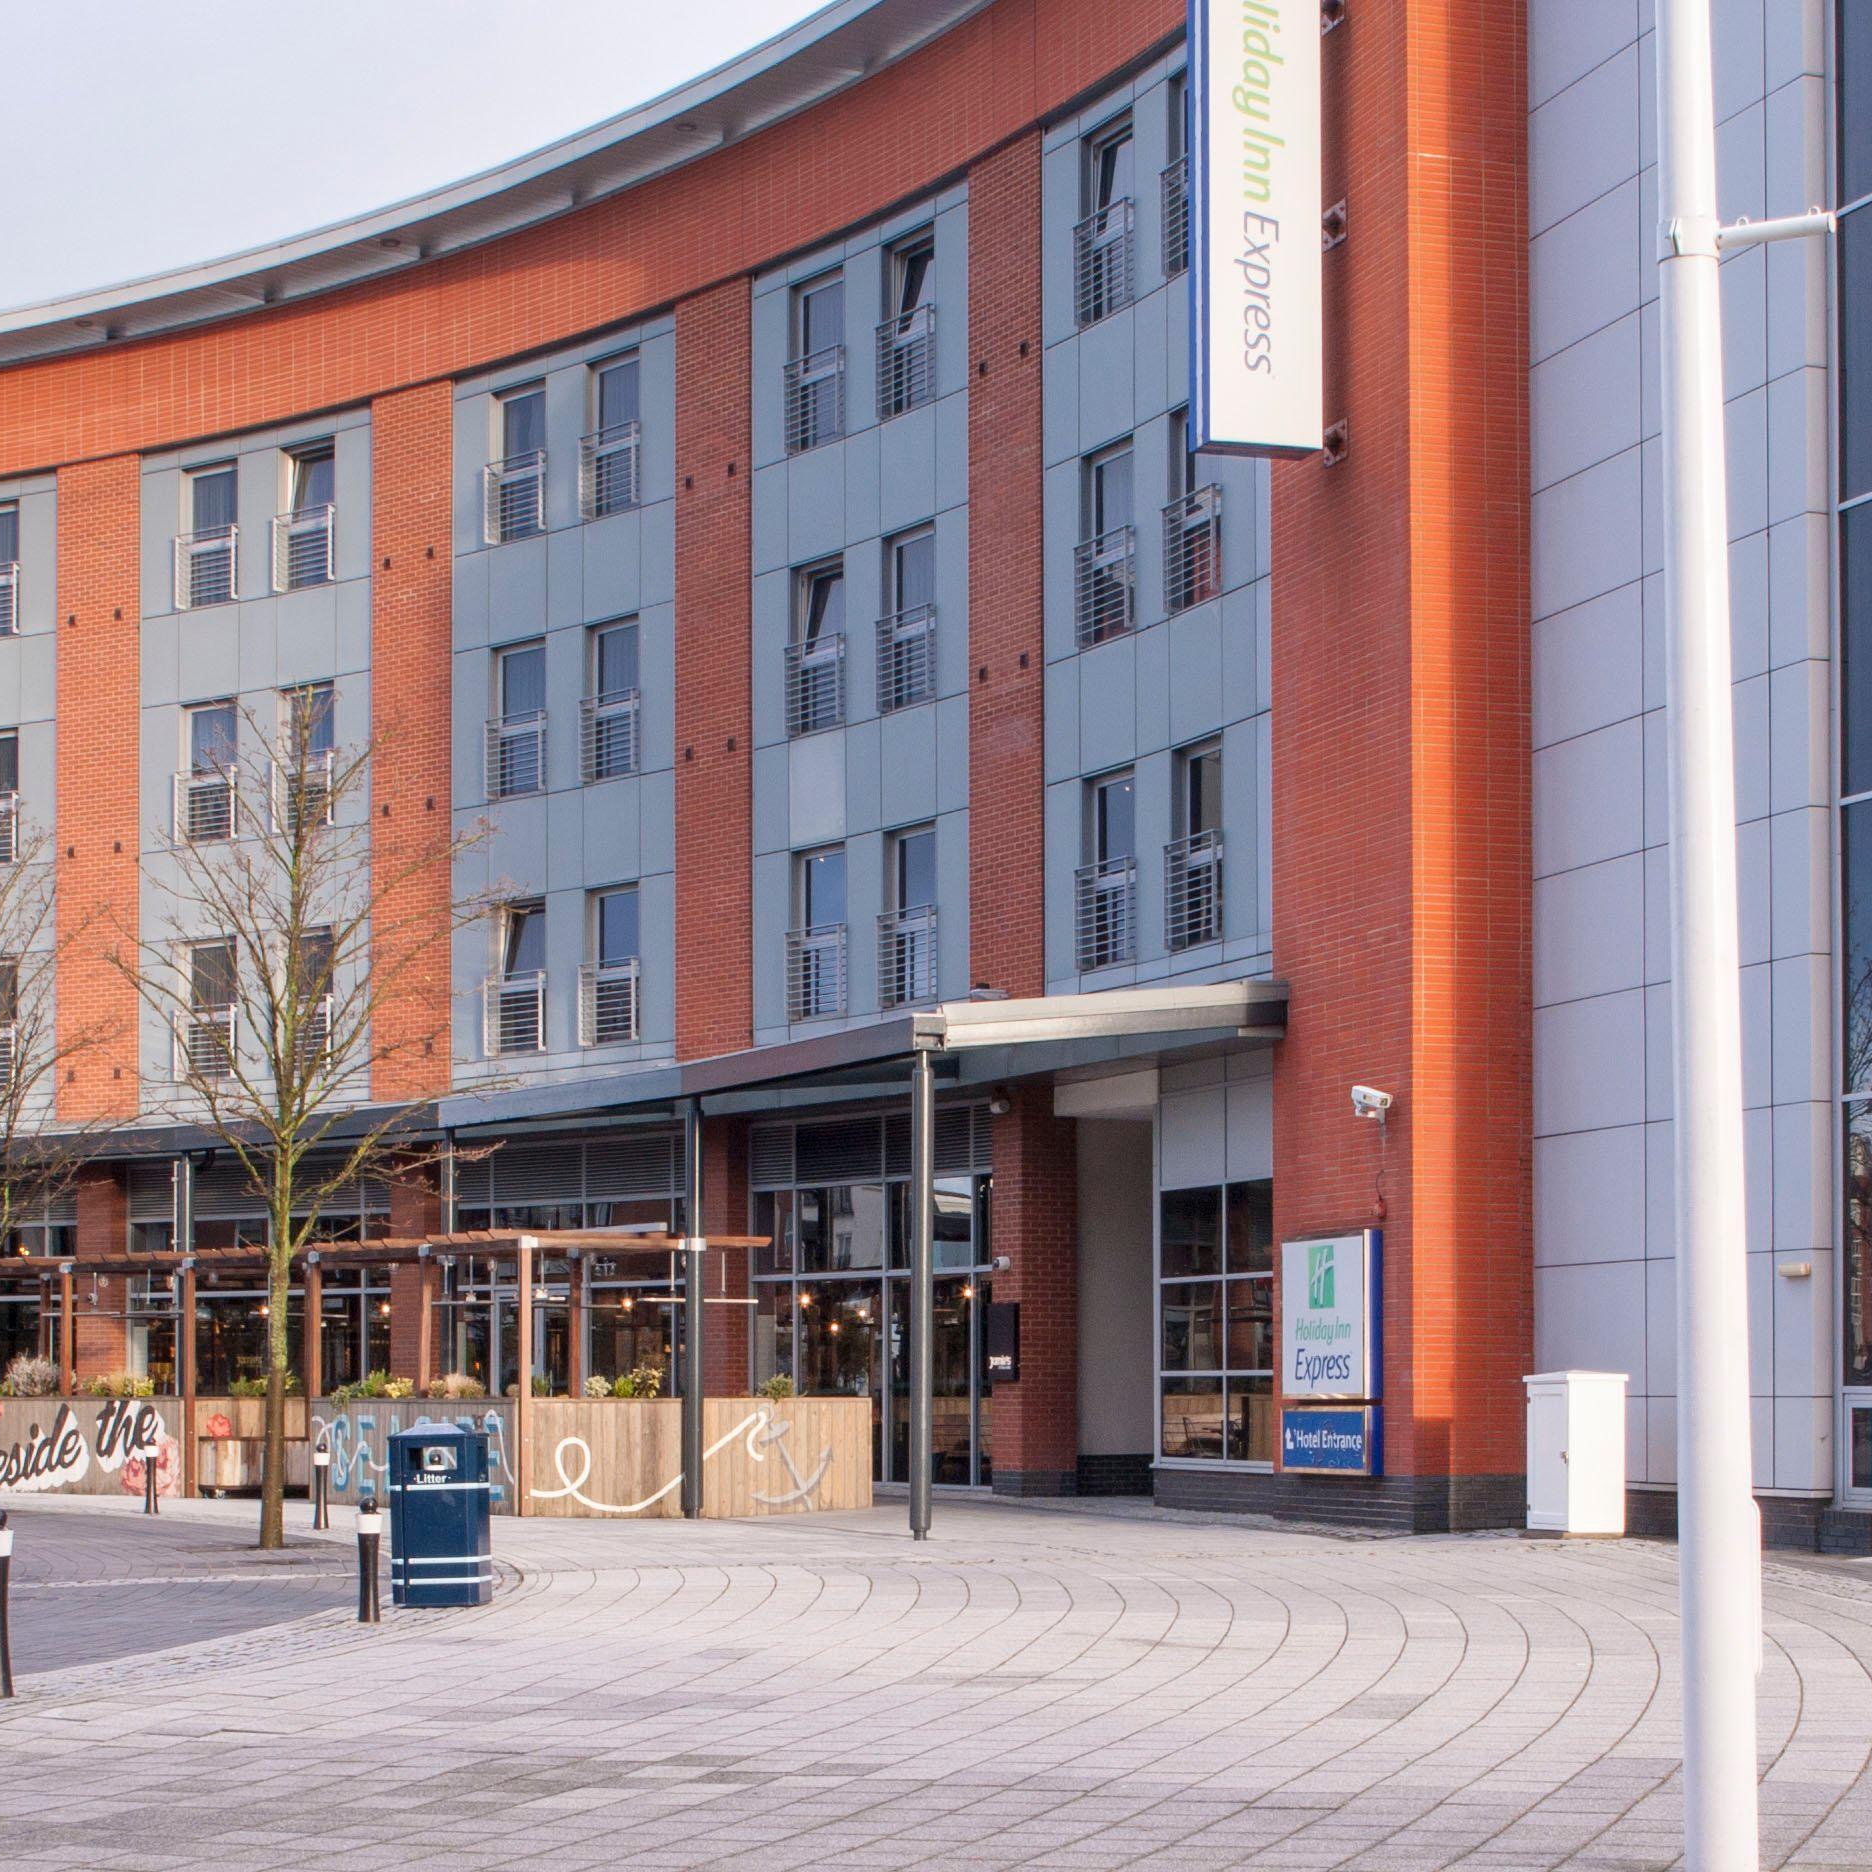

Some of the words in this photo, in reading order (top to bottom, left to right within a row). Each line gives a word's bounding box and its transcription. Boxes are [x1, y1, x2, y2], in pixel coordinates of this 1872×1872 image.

[1243, 128, 1285, 203] Inn
[1233, 211, 1279, 375] Express
[1296, 1317, 1334, 1345] Holiday
[1335, 1316, 1351, 1339] Inn
[1295, 1348, 1351, 1389] Express
[96, 1400, 161, 1462] the
[1296, 1429, 1321, 1449] Hotel
[1322, 1430, 1363, 1450] Entrance
